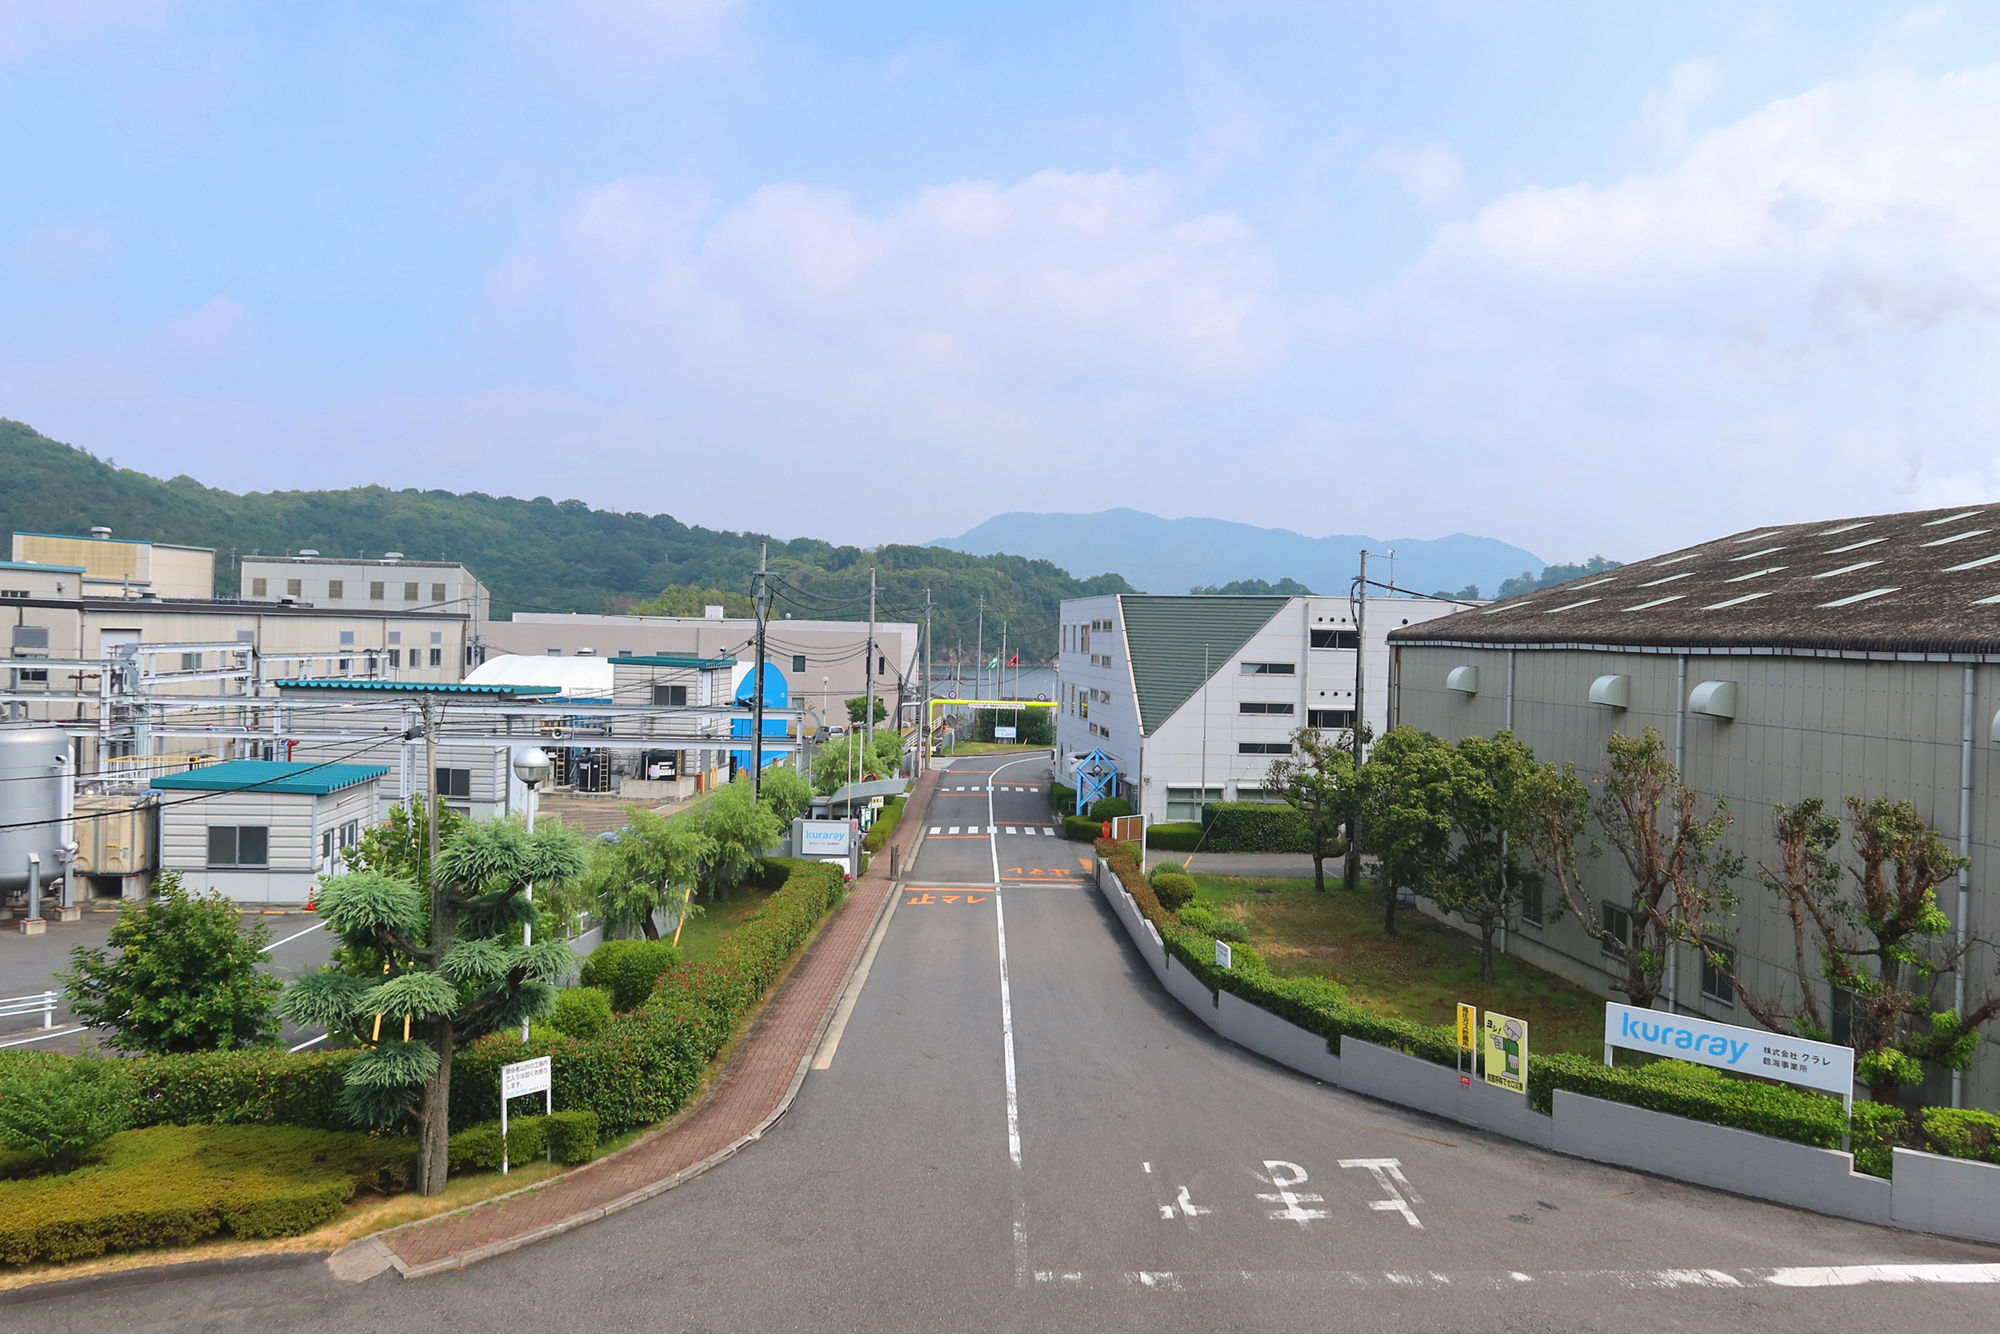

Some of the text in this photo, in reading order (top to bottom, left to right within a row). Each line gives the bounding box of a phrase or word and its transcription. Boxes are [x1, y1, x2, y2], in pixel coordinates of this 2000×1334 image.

[806, 831, 845, 841] kuraray
[906, 893, 988, 904] 止マレ
[1622, 1012, 1749, 1064] kuraray
[1801, 1053, 1831, 1066] クラレ
